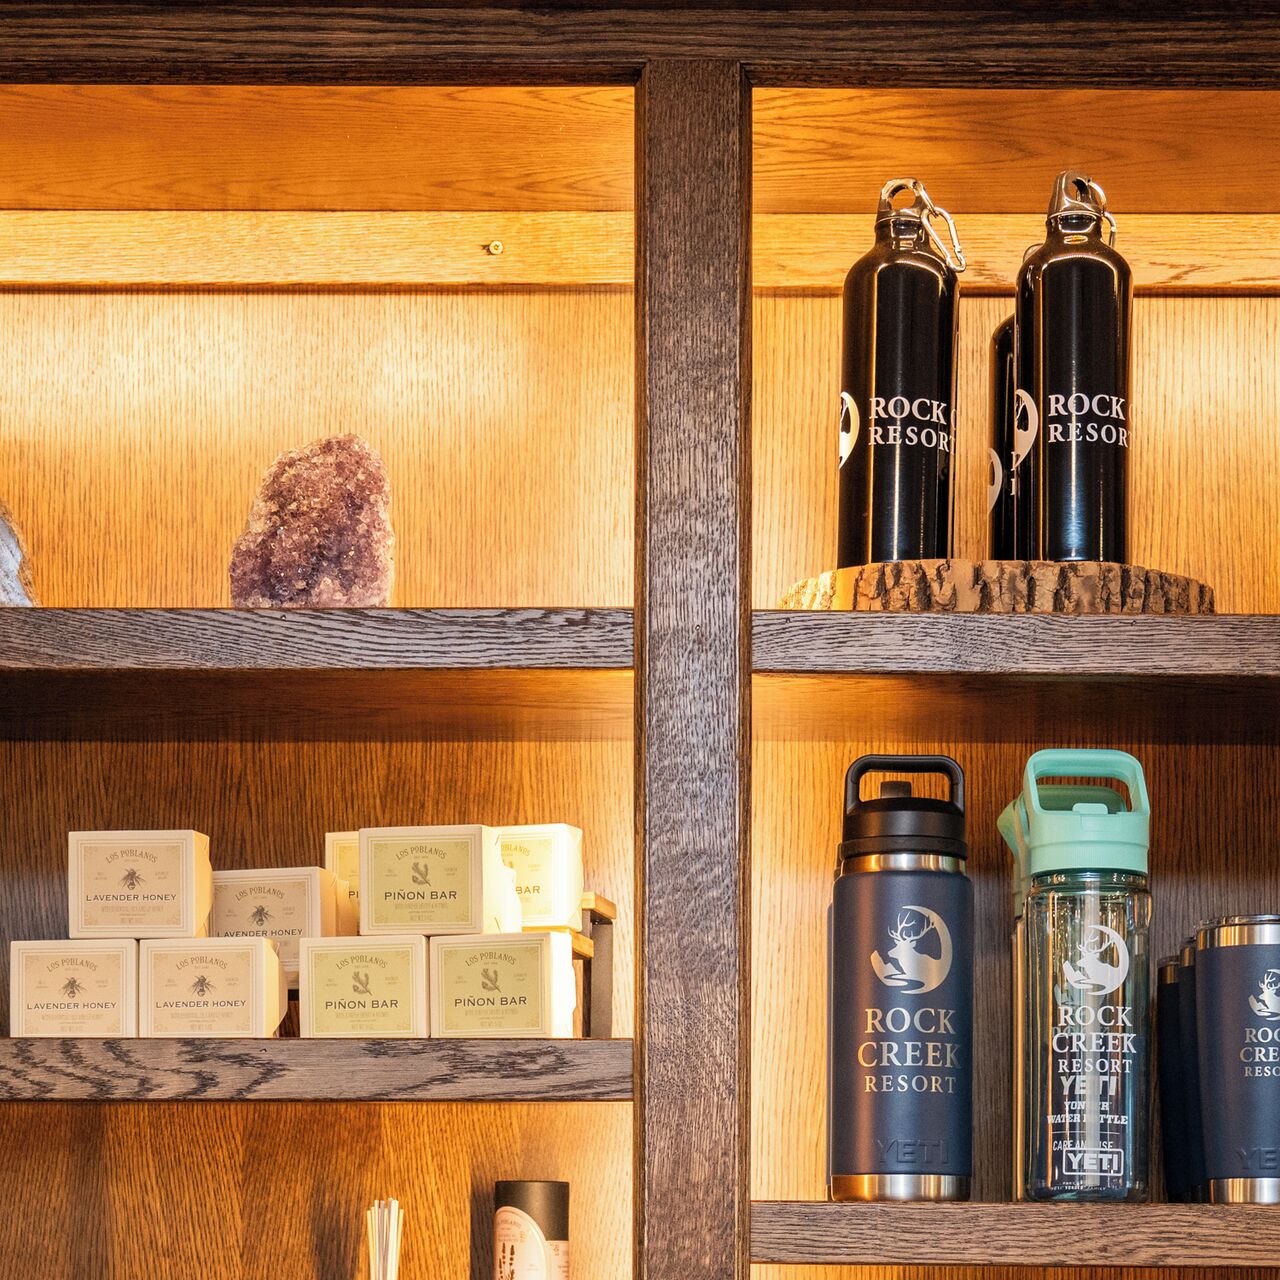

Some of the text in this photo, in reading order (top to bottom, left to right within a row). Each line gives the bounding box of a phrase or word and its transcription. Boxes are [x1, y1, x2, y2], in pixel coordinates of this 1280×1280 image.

[869, 396, 947, 425] ROCK
[1048, 393, 1126, 420] ROCK
[384, 889, 457, 901] PIÑON BAR
[26, 1002, 80, 1010] LAVENDER
[155, 1000, 209, 1008] LAVENDER
[325, 998, 398, 1010] PIÑON BAR
[454, 995, 527, 1007] PIÑON BAR
[864, 1007, 956, 1034] ROCK
[1058, 1006, 1133, 1027] ROCK
[1052, 1032, 1136, 1054] CREEK
[857, 1041, 962, 1069] CREEK
[1057, 1059, 1132, 1073] RESORT
[864, 1074, 956, 1094] RESORT
[874, 1140, 949, 1164] YETI
[1067, 1153, 1118, 1170] YETI
